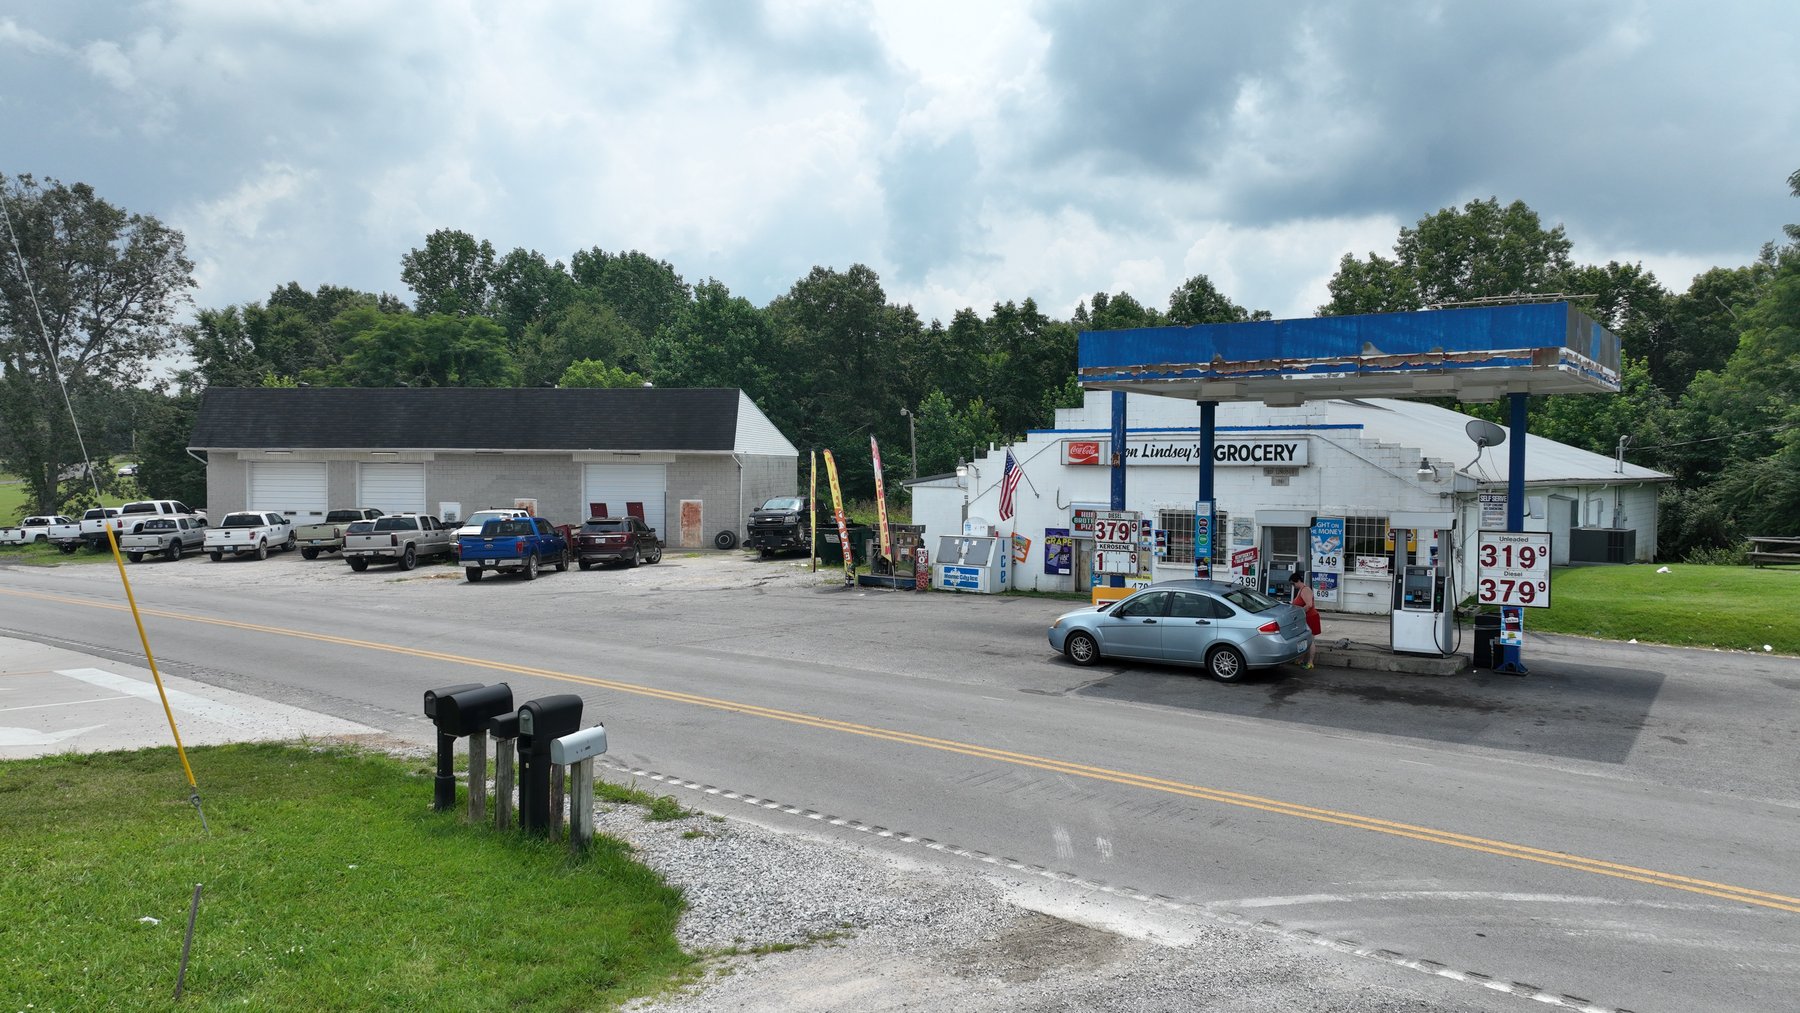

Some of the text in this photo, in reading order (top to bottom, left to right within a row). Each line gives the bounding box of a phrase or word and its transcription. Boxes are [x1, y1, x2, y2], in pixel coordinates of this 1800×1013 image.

[1070, 445, 1096, 455] Coca-Cola
[1125, 443, 1298, 462] on Lindsey's GROCERY
[1045, 536, 1072, 546] GRAPE
[1099, 543, 1130, 551] KEROSENE
[1097, 552, 1103, 571] 1
